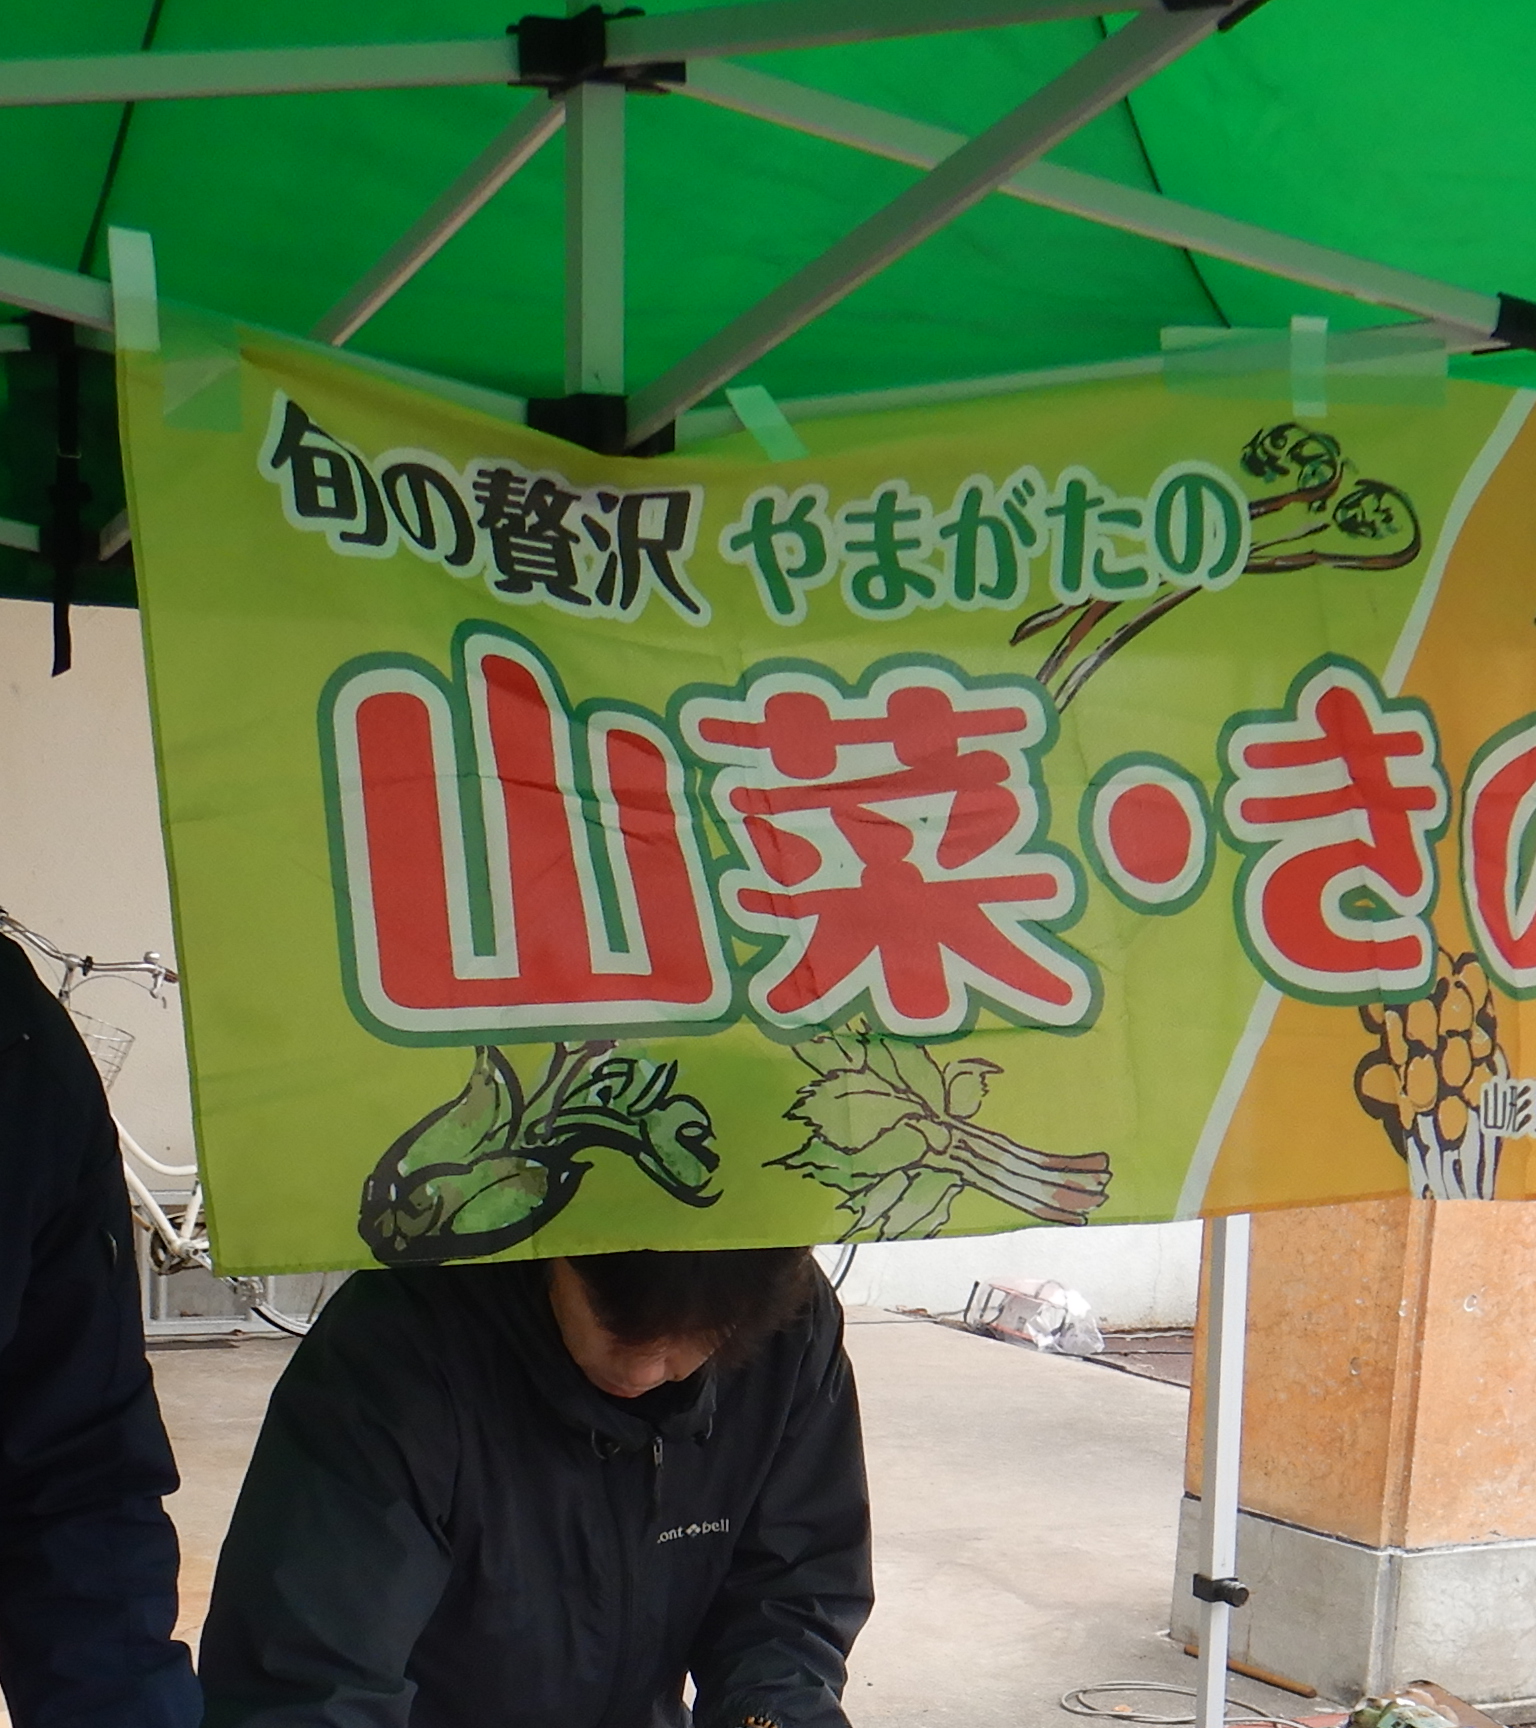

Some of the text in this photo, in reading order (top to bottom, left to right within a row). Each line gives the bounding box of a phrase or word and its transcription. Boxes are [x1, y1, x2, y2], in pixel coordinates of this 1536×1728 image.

[267, 400, 1245, 620] 旬の贅沢 やまがたの
